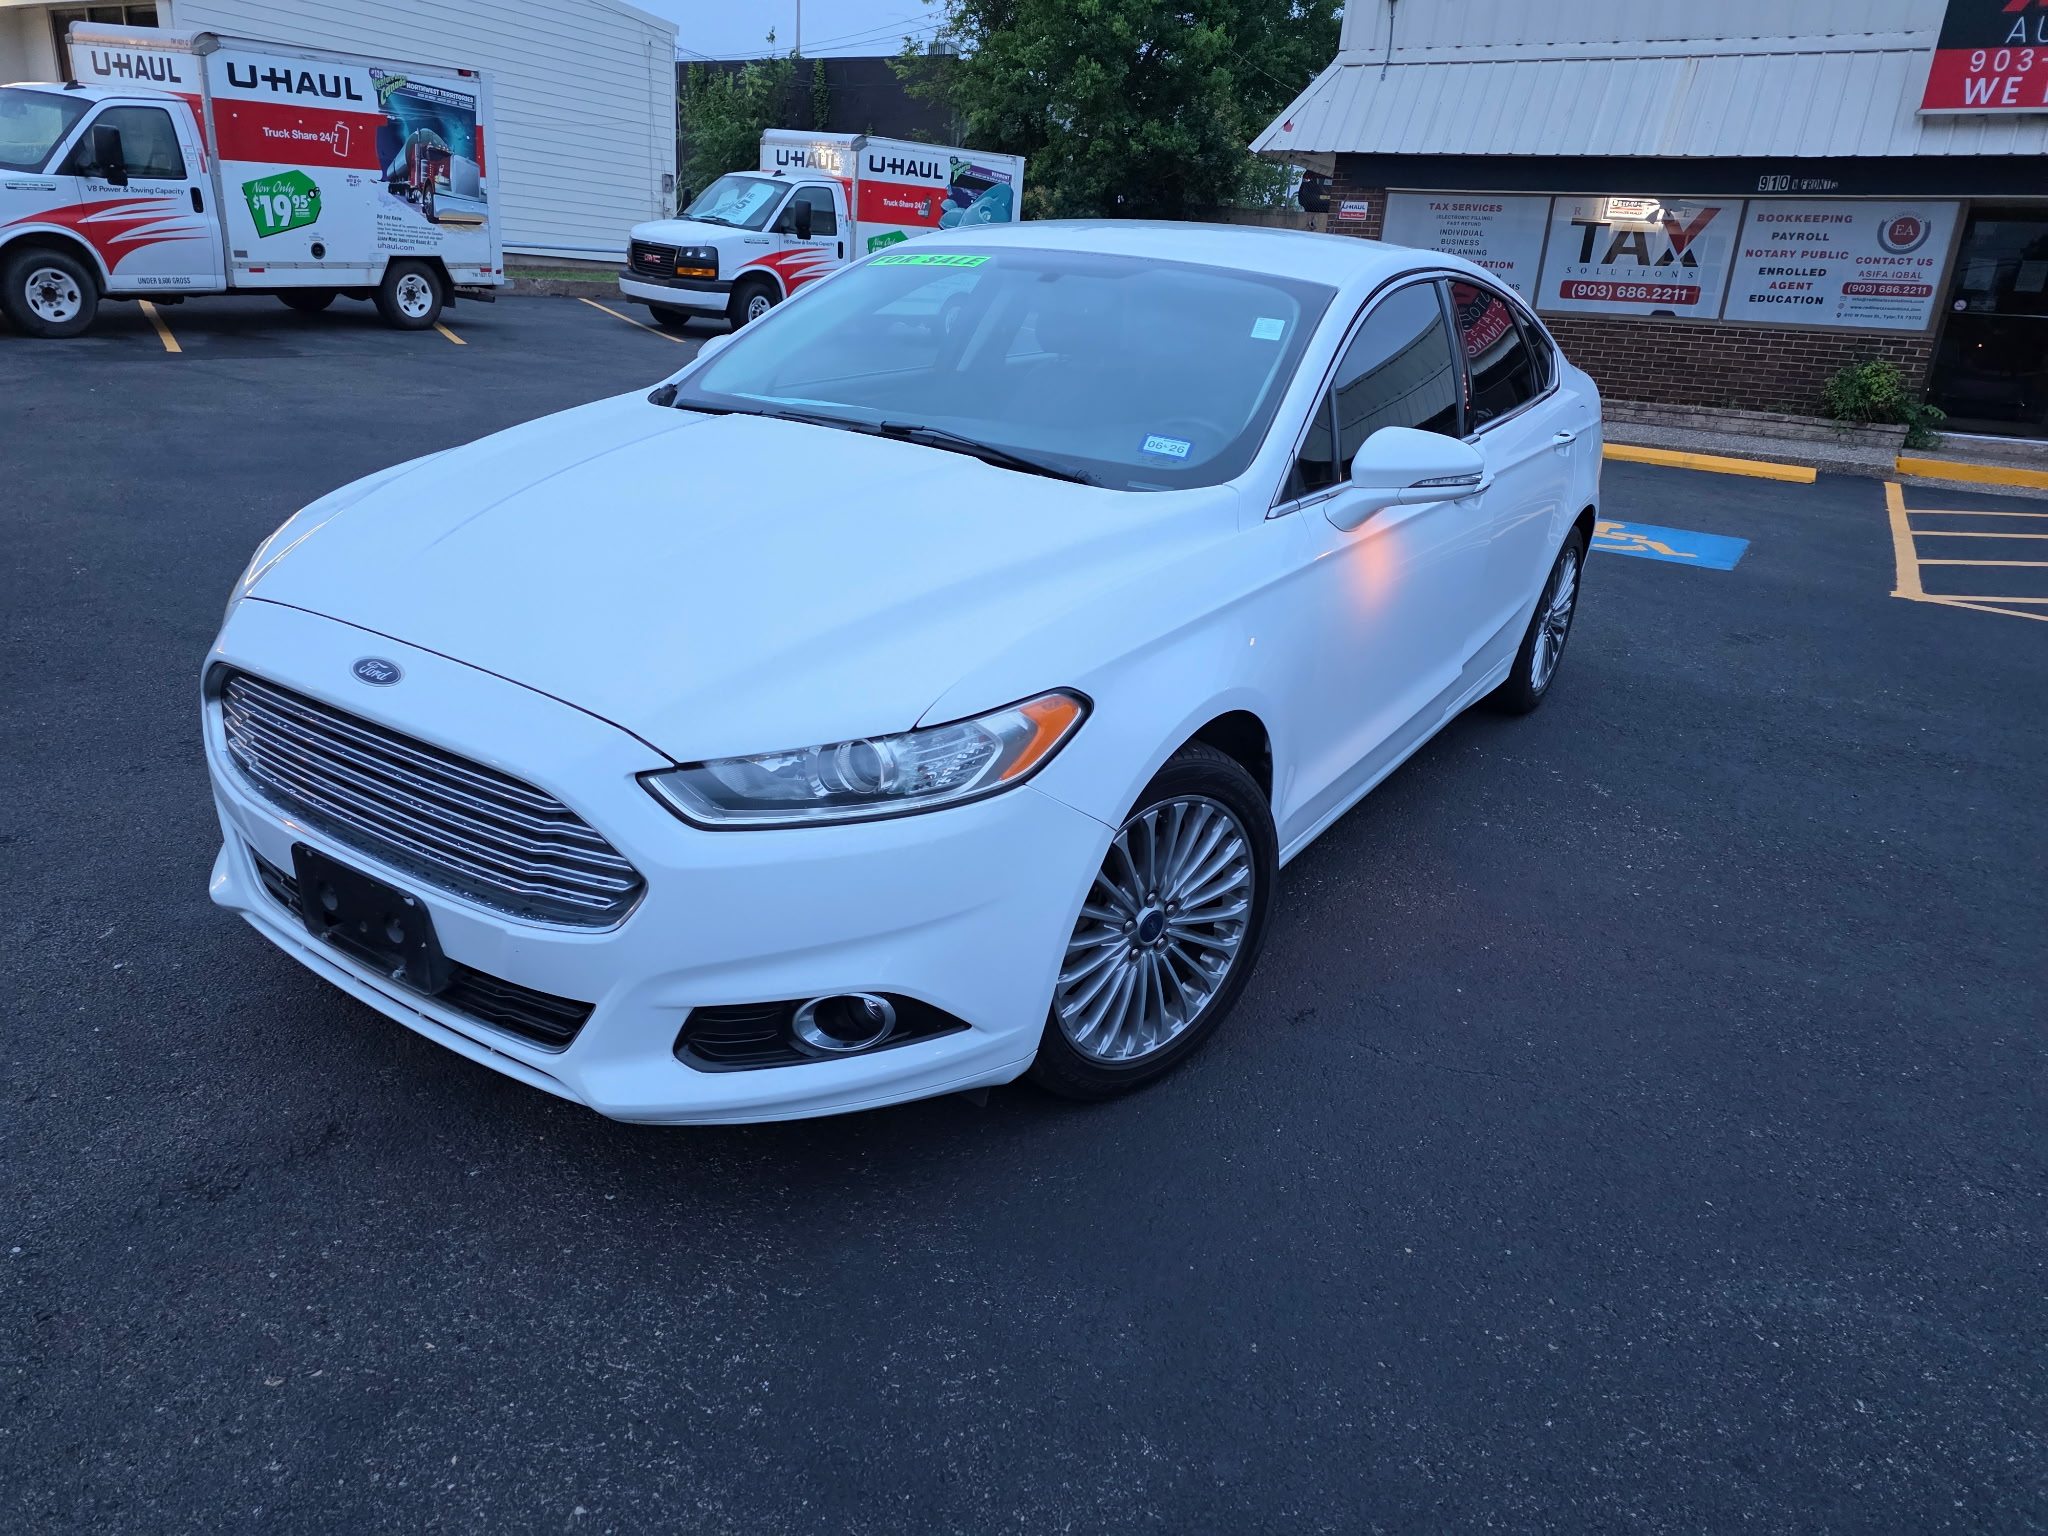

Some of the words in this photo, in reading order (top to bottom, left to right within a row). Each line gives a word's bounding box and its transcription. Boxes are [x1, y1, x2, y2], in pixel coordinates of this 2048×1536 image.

[91, 51, 181, 83] U-HAUL
[226, 62, 362, 100] U-HAUL
[406, 82, 440, 96] NORTHWEST
[440, 90, 474, 102] TERRITORIES
[1966, 76, 2023, 104] WE
[262, 126, 290, 138] Truck
[292, 130, 318, 140] Share
[320, 132, 339, 144] 24/7
[869, 154, 943, 180] U-HAUL
[252, 182, 270, 193] Now
[272, 180, 296, 197] Only
[1758, 176, 1790, 190] 910
[130, 187, 154, 195] Towing
[155, 187, 184, 195] Capacity
[883, 198, 898, 207] Truck
[899, 200, 914, 208] Share
[1428, 203, 1449, 211] TAX
[1452, 204, 1503, 212] SERVICES
[1757, 214, 1853, 223] BOOKKEEPING
[1440, 229, 1484, 237] INDIVIDUAL
[1894, 224, 1915, 236] EA
[1570, 208, 1722, 268] TAX
[1772, 232, 1830, 241] PAYROLL
[378, 242, 415, 251] uhaul.com
[1448, 248, 1487, 256] PLANNING
[643, 253, 661, 263] GMC
[872, 255, 919, 264] FOR
[922, 256, 986, 265] SALE
[1745, 249, 1797, 258] NOTARY
[1801, 251, 1849, 260] PUBLIC
[1856, 257, 1914, 265] CONTACT
[1917, 258, 1933, 266] US
[1566, 266, 1694, 279] SOLUTIONS
[1758, 267, 1826, 277] ENROLLED
[1858, 270, 1888, 278] ASIFA
[1891, 271, 1923, 279] IQBAL
[1571, 283, 1612, 300] (903)
[1616, 286, 1687, 300] 686.2211
[1769, 282, 1813, 290] AGENT
[1847, 284, 1876, 294] (903)
[1879, 285, 1927, 295] 686.2211
[1748, 294, 1824, 304] EDUCATION
[1147, 440, 1185, 453] 06-26
[359, 661, 393, 680] Ford
